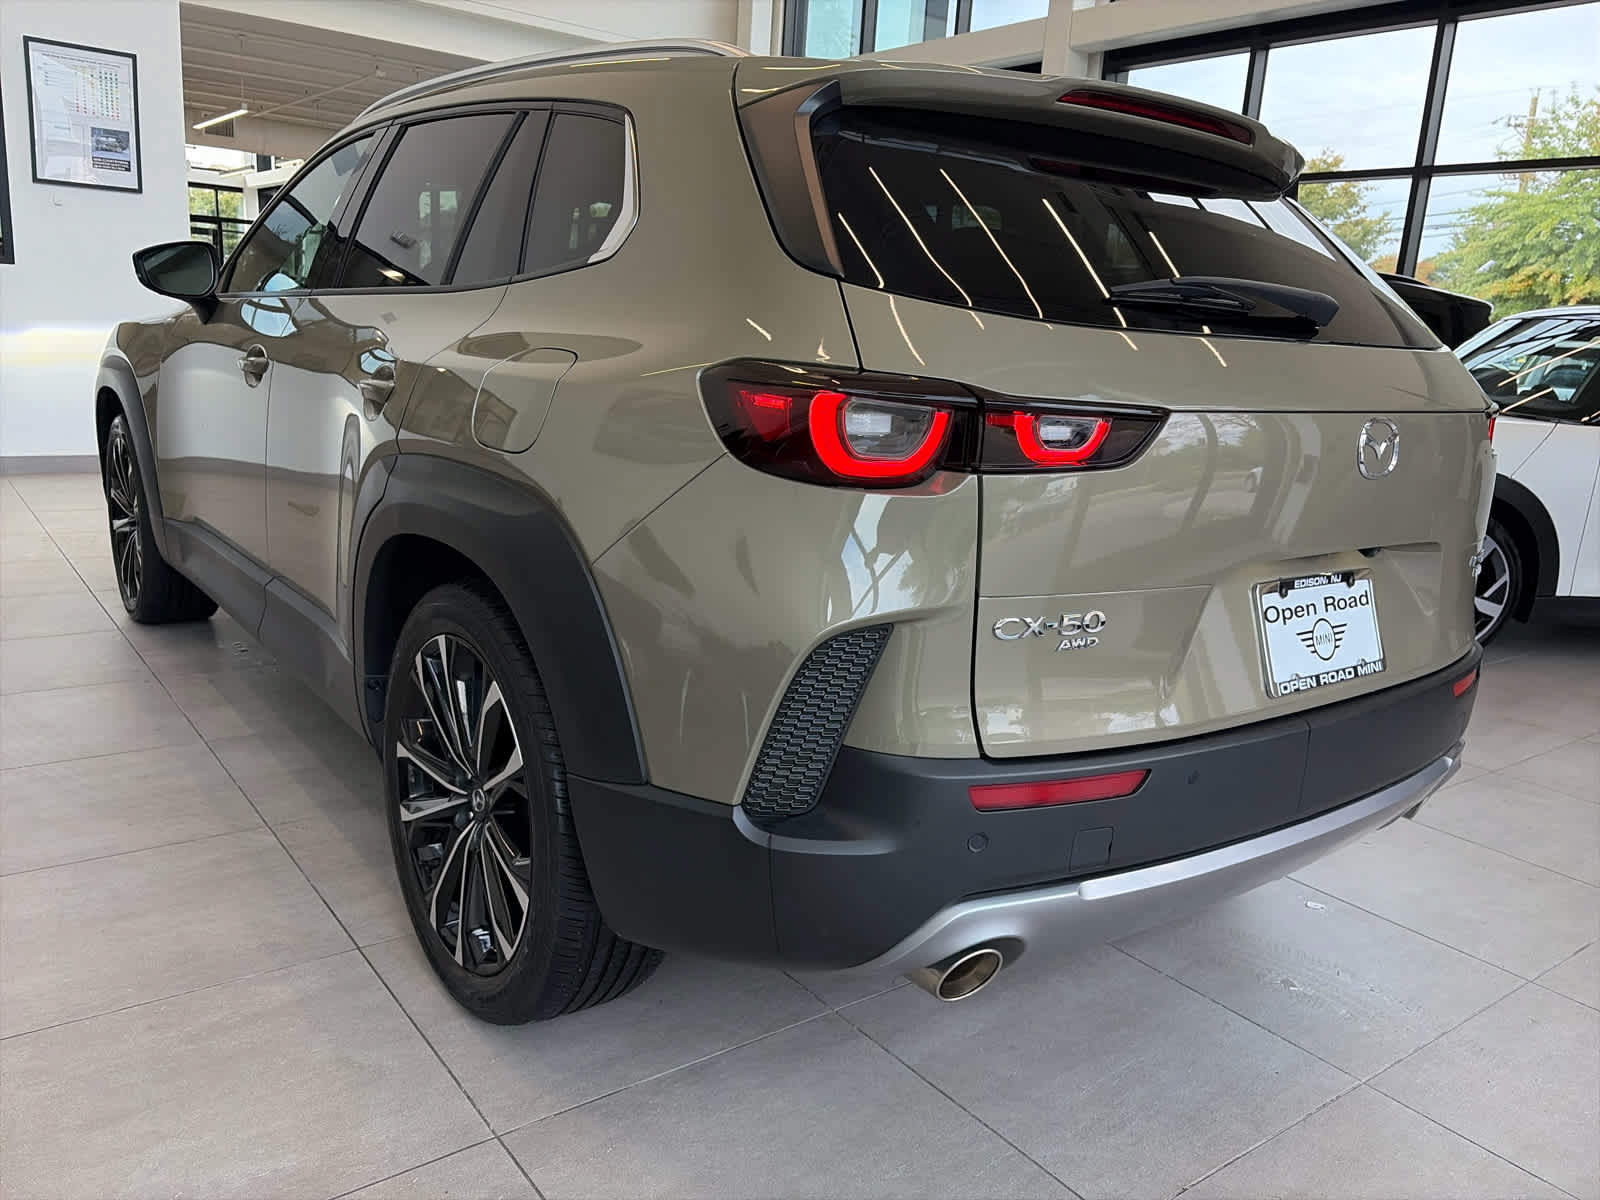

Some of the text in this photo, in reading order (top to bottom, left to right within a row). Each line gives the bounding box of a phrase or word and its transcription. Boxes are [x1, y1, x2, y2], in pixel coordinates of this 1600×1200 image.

[1330, 574, 1342, 583] NJ
[1264, 590, 1369, 625] Open Road
[992, 610, 1106, 640] CX-50
[1056, 637, 1098, 651] AWD
[1280, 661, 1383, 694] OPEN ROAD MINI
